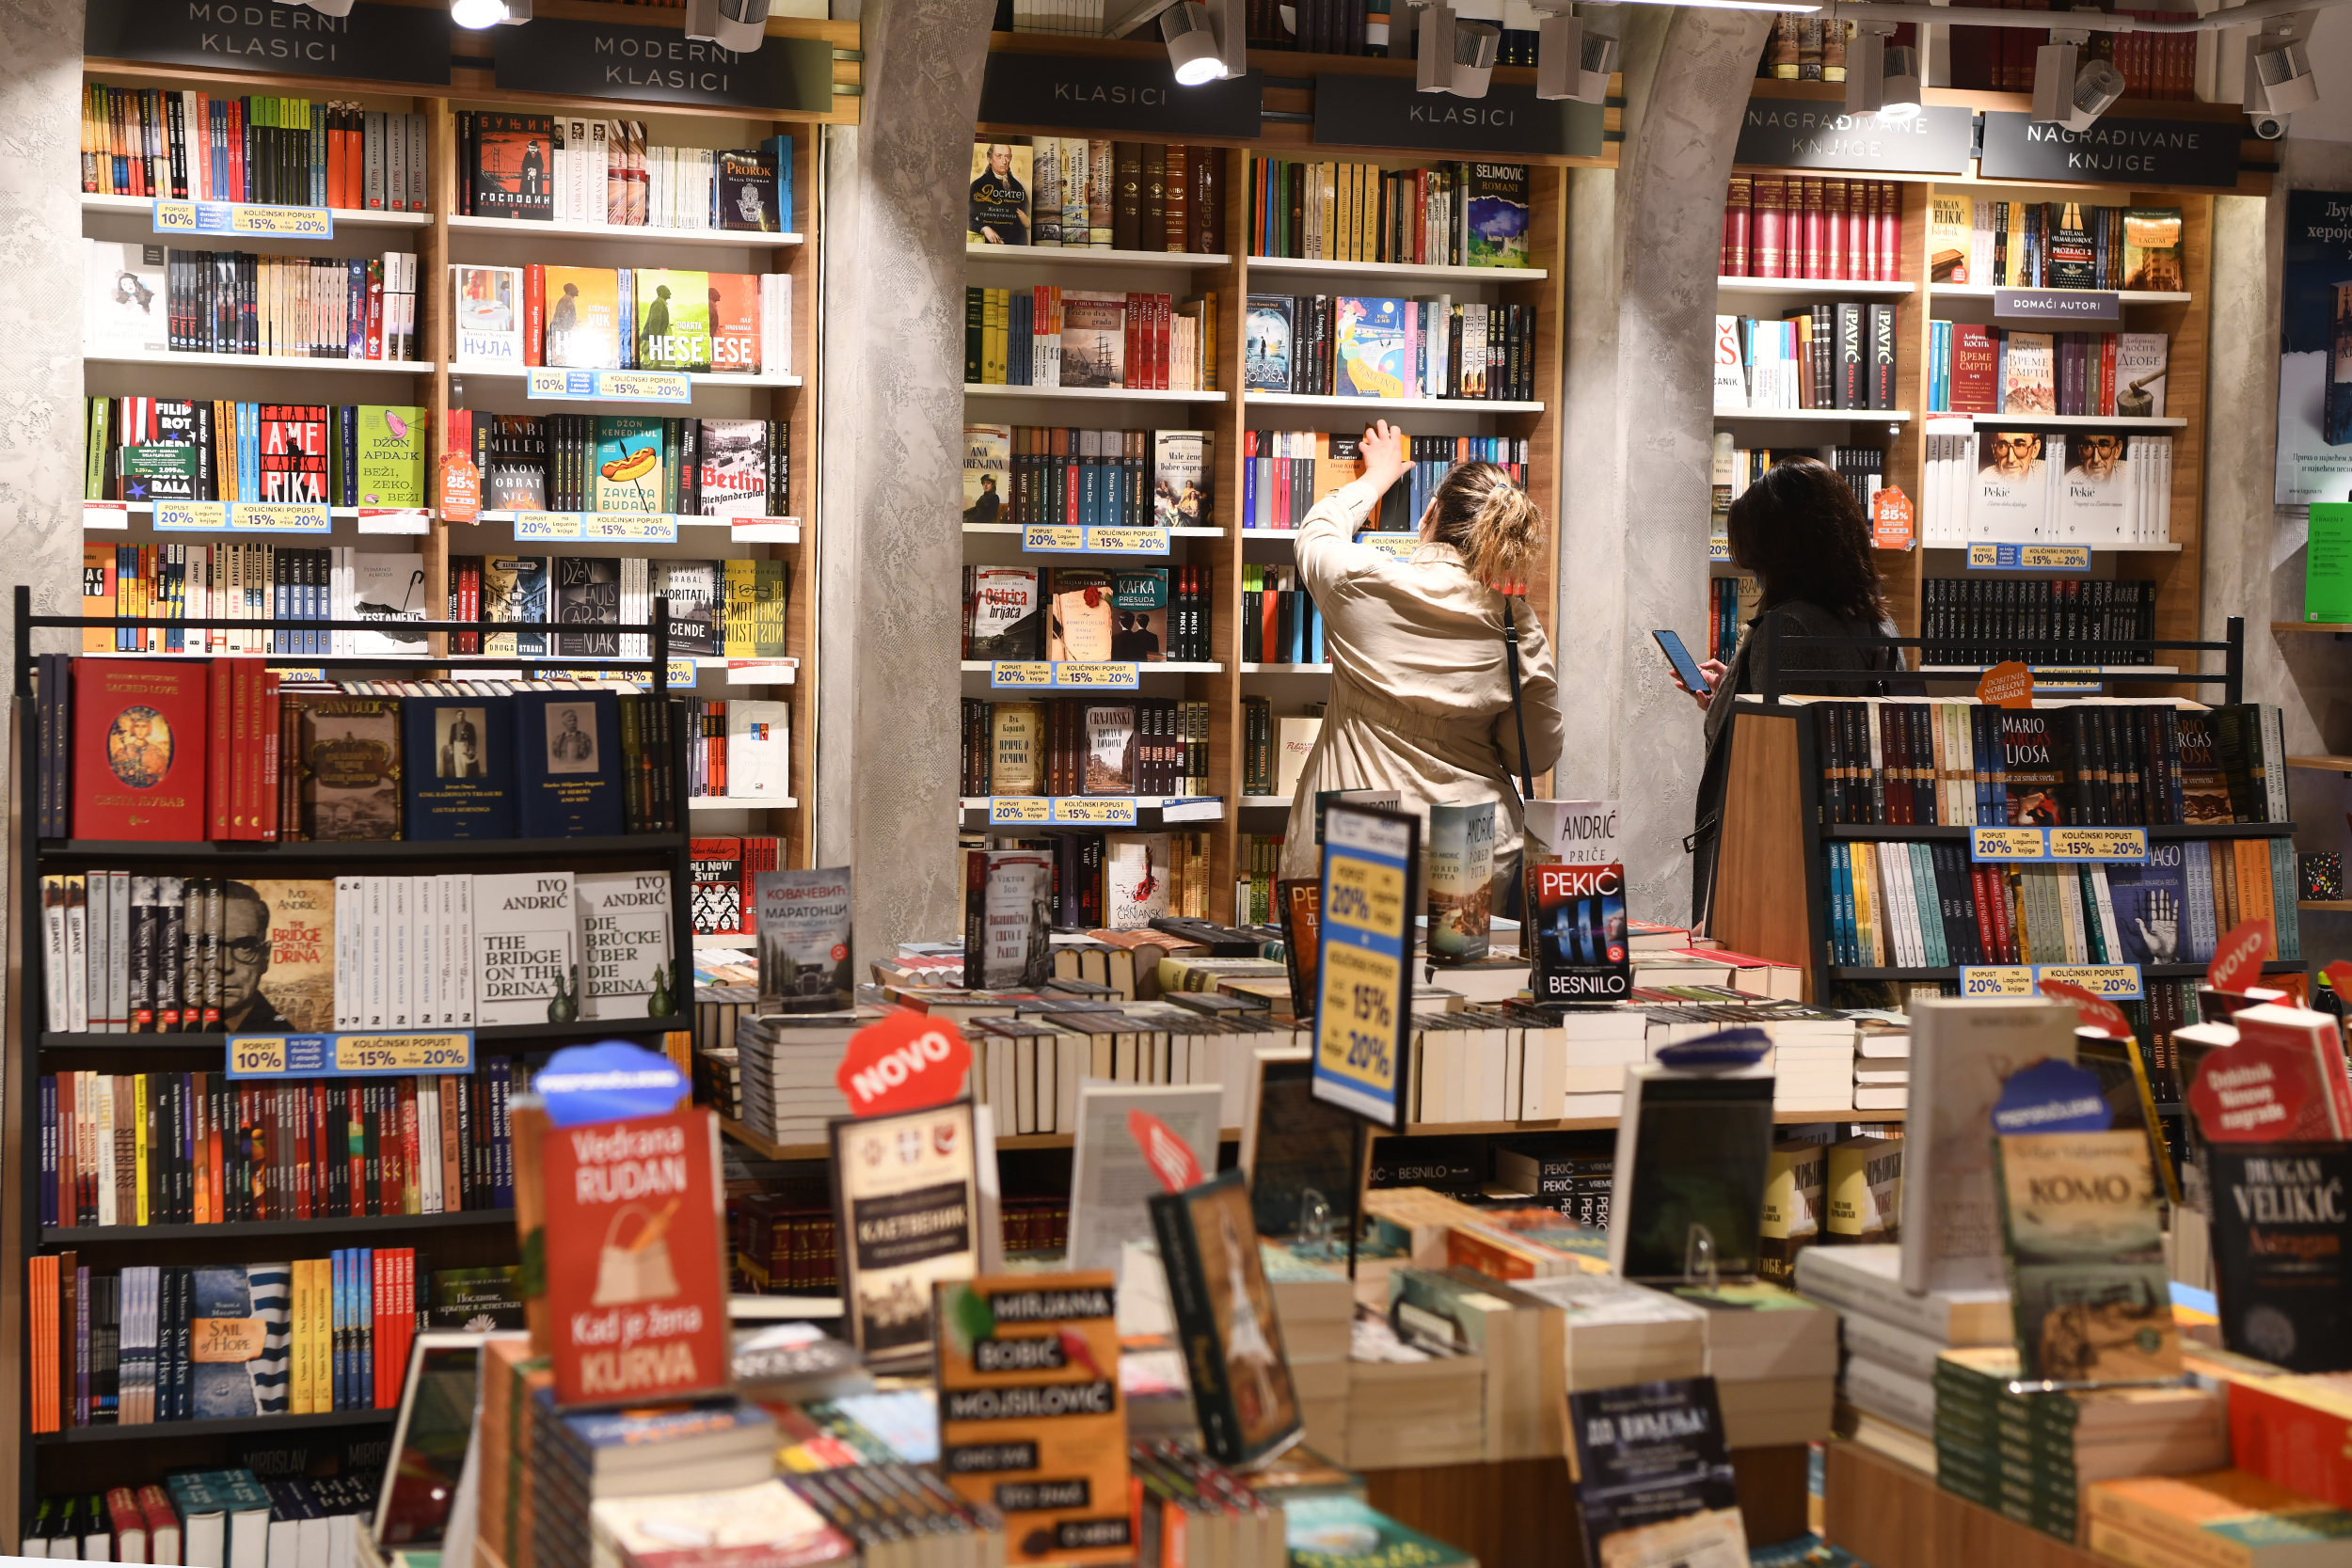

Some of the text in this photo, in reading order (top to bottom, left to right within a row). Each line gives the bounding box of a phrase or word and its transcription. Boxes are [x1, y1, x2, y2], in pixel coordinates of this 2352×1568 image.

[189, 3, 348, 34] MODERNI
[201, 34, 336, 62] KLASICI
[595, 37, 739, 65] MODERNI
[606, 66, 728, 91] KLASICI
[1055, 83, 1166, 105] KLASICI
[1410, 105, 1514, 126] KLASICI
[2027, 125, 2200, 150] NAGRAĐIVANE
[1792, 137, 1883, 157] KNJIGE
[2069, 152, 2155, 171] KNJIGE
[726, 162, 771, 177] PROROK
[1476, 163, 1524, 182] SELIMOVIĆ
[1482, 181, 1518, 193] ROMANI
[1933, 199, 1959, 209] DRAGAN
[161, 214, 194, 226] 10%
[244, 210, 316, 219] KOLIČINSKI POPUST
[248, 218, 276, 230] 15%
[295, 220, 326, 232] 20%
[2053, 246, 2092, 256] PROZRACI 2
[2013, 297, 2100, 310] DOMAĆI AUTORI
[589, 313, 611, 326] VUK
[675, 321, 702, 330] SIDARTA
[1845, 309, 1861, 363] PAVIĆ
[464, 338, 512, 356] НУЛА
[649, 334, 704, 361] HESE
[710, 337, 752, 363] ESE
[1961, 351, 1992, 361] ВРЕМЕ
[2010, 354, 2049, 367] ВРЕМЕ
[2118, 353, 2160, 367] ДЕОБЕ
[1960, 361, 1992, 371] СМРТИ
[2009, 367, 2049, 378] СМРТИ
[155, 403, 191, 416] FILIP
[162, 417, 191, 430] ROT
[492, 422, 544, 436] HENRI
[265, 422, 318, 455] AME
[373, 436, 410, 448] DŽON
[491, 439, 545, 452] MILER
[363, 450, 420, 461] APDAJK
[971, 447, 987, 456] ANA
[446, 475, 475, 490] 25%
[496, 478, 541, 488] OBRAT
[701, 467, 764, 491] Berlin
[153, 480, 190, 495] RALA
[270, 472, 322, 503] RIKA
[603, 488, 655, 498] ZAVERA
[1983, 486, 2010, 498] Pekić
[388, 489, 419, 502] BEŽI
[502, 492, 535, 502] NICA
[243, 505, 284, 514] KOLIČINSKI
[603, 500, 656, 510] BUDALA
[161, 512, 194, 524] 20%
[247, 514, 275, 526] 15%
[294, 515, 325, 527] 20%
[1881, 510, 1909, 520] 25%
[1973, 553, 1995, 562] 10%
[2032, 555, 2052, 564] 15%
[2064, 556, 2086, 565] 20%
[669, 576, 703, 584] HRABAL
[1119, 579, 1154, 594] KAFKA
[660, 588, 706, 600] MORITATI
[985, 588, 1027, 606] Oštrica
[990, 607, 1020, 620] brijača
[489, 644, 514, 653] DRUGA
[1984, 679, 2026, 695] NOBELOVE
[1987, 672, 2026, 688] DOBITNIK
[105, 684, 178, 695] SACRED LOVE
[1985, 688, 2025, 704] NAGRADE
[1089, 711, 1130, 725] CRNJANSKI
[2003, 717, 2044, 734] MARIO
[2006, 745, 2049, 766] LJOSA
[2021, 773, 2038, 782] smak
[94, 795, 135, 807] СВЕТА
[1467, 811, 1494, 845] ANDRIĆ
[1562, 811, 1615, 841] ANDRIĆ
[2061, 830, 2104, 840] KOLIČINSKI
[1569, 845, 1605, 863] PRIČE
[1979, 840, 2012, 854] 20%
[2018, 846, 2036, 855] knjige
[2067, 841, 2094, 855] 15%
[2113, 841, 2143, 855] 20%
[694, 871, 720, 881] SVET
[1543, 866, 1619, 896] PEKIĆ
[537, 879, 567, 893] IVO
[636, 877, 664, 890] IVO
[603, 890, 666, 907] ANDRIĆ
[767, 885, 846, 901] КОВАЧЕВИЋ
[277, 898, 317, 911] ANDRIĆ
[503, 893, 568, 911] ANDRIĆ
[765, 903, 846, 919] МАРАТОНЦИ
[584, 917, 617, 930] DIE
[272, 928, 321, 942] BRIDGE
[484, 935, 526, 949] THE
[585, 929, 661, 946] BRÜCKE
[274, 949, 320, 963] DRINA
[485, 949, 561, 965] BRIDGE
[586, 946, 638, 962] ÜBER
[2213, 930, 2262, 989] NOVO
[485, 965, 562, 980] ON THE
[587, 964, 619, 977] DIE
[486, 982, 549, 997] DRINA
[588, 979, 646, 994] DRINA
[1549, 975, 1626, 994] BESNILO
[243, 1042, 276, 1051] POPUST
[351, 1036, 452, 1048] KOLIČINSKI POPUST
[237, 1053, 282, 1068] 10%
[358, 1051, 396, 1068] 15%
[422, 1050, 466, 1065] 20%
[850, 1030, 951, 1102] NOVO
[2208, 1065, 2274, 1091] Dobitnik
[2221, 1103, 2285, 1131] nagrade
[571, 1126, 684, 1166] Vedrana
[1398, 1164, 1447, 1180] BESNILO
[1544, 1160, 1574, 1176] PEKIĆ
[576, 1160, 687, 1204] RUDAN
[2029, 1175, 2130, 1206] KOMO
[2233, 1178, 2344, 1223] VELIKIĆ
[209, 1321, 243, 1338] SAIL
[571, 1310, 616, 1347] Kad
[645, 1303, 701, 1342] žena
[200, 1337, 251, 1354] of HOPE
[977, 1336, 1061, 1370] BOBIĆ
[580, 1345, 696, 1394] KURVA
